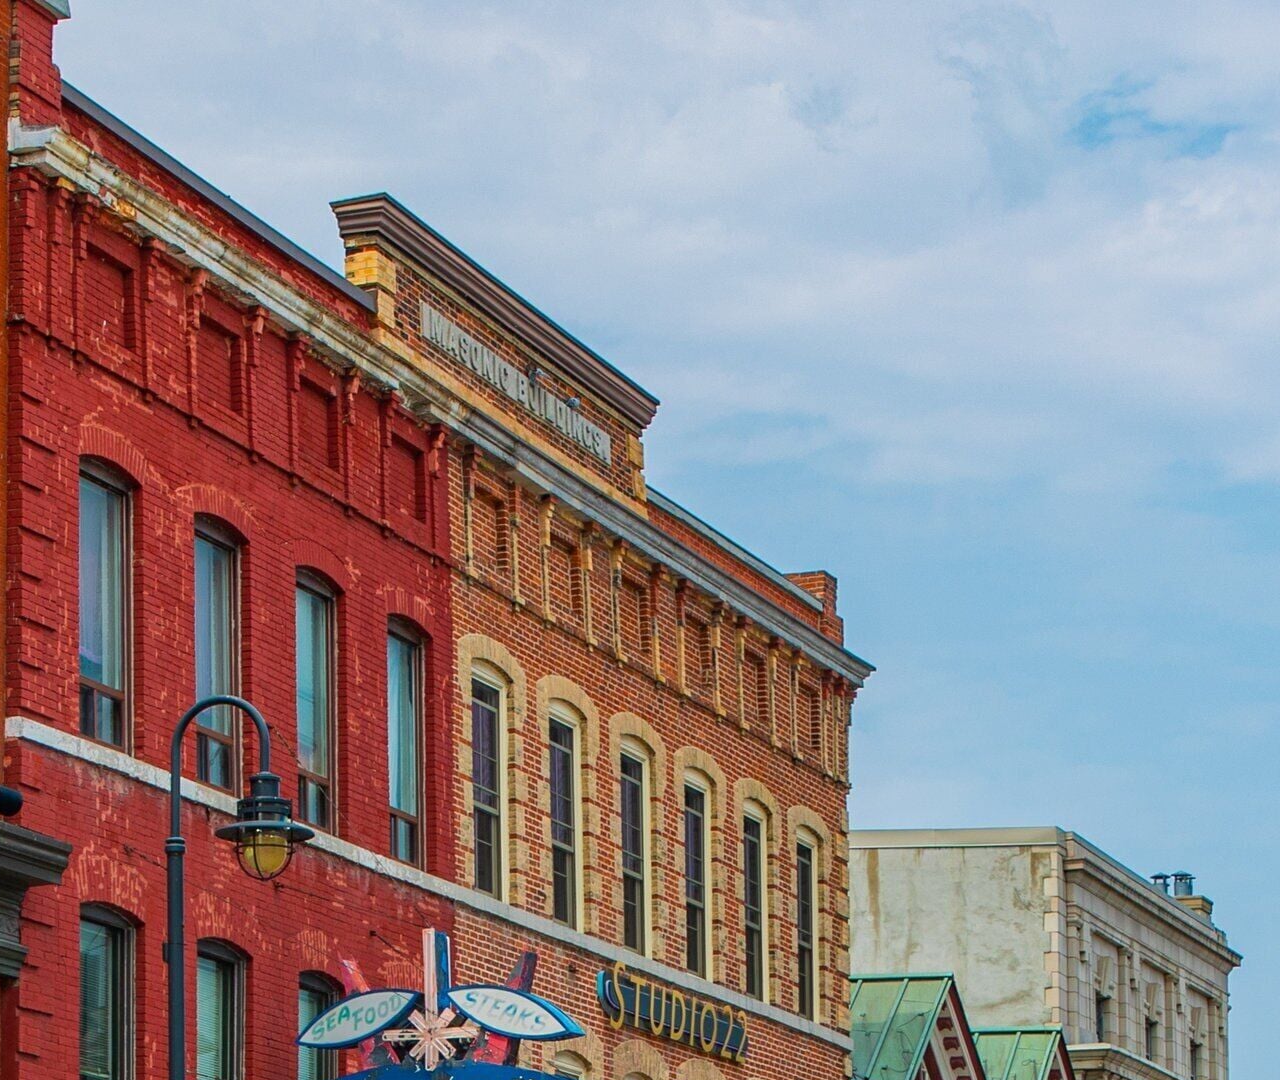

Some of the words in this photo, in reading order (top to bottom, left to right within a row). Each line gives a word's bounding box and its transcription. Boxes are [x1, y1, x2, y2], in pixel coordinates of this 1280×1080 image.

[427, 306, 508, 393] MASONIC
[310, 992, 405, 1038] SEAFOOD
[464, 990, 548, 1032] STEAKS
